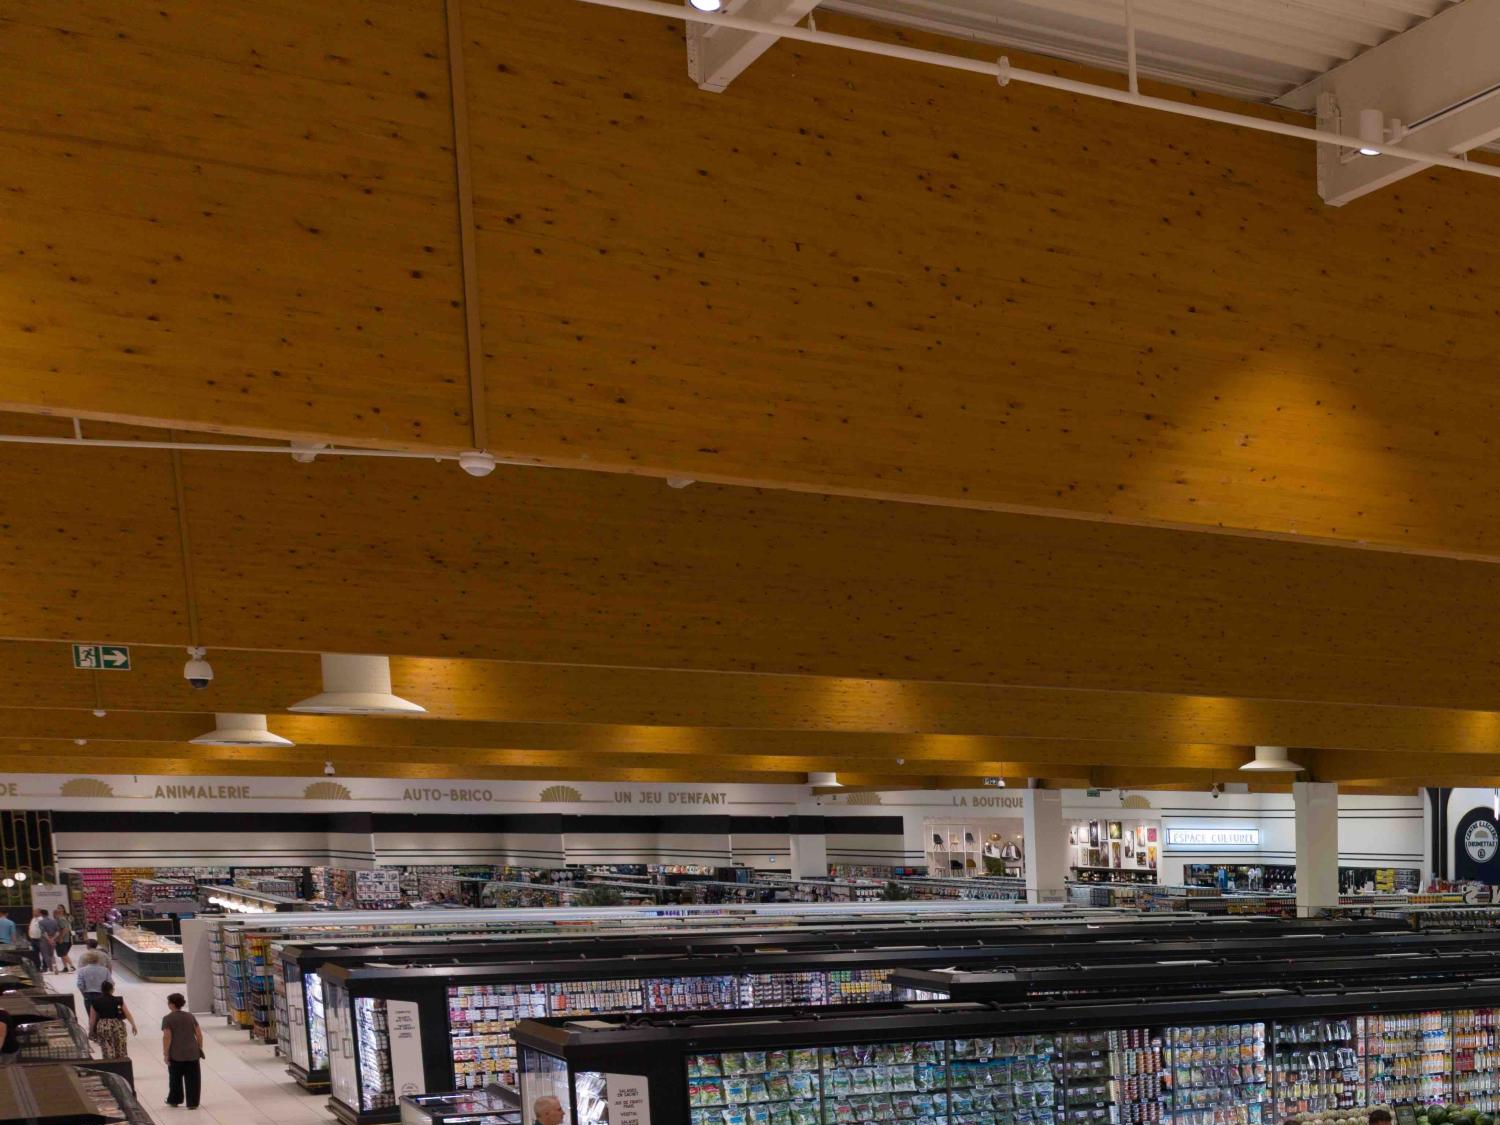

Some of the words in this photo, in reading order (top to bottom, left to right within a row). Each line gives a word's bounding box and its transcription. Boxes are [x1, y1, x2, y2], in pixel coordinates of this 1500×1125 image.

[155, 785, 250, 799] ANIMALERIE
[403, 788, 493, 802] AUTO-BRICO
[614, 792, 632, 803] UN
[639, 792, 661, 804] JEU
[668, 792, 727, 805] D'ENFANT
[953, 796, 967, 807] LA
[973, 797, 1023, 808] BOUTIQUE
[1173, 832, 1205, 843] ESPACE
[1211, 833, 1256, 843] CULTUREL
